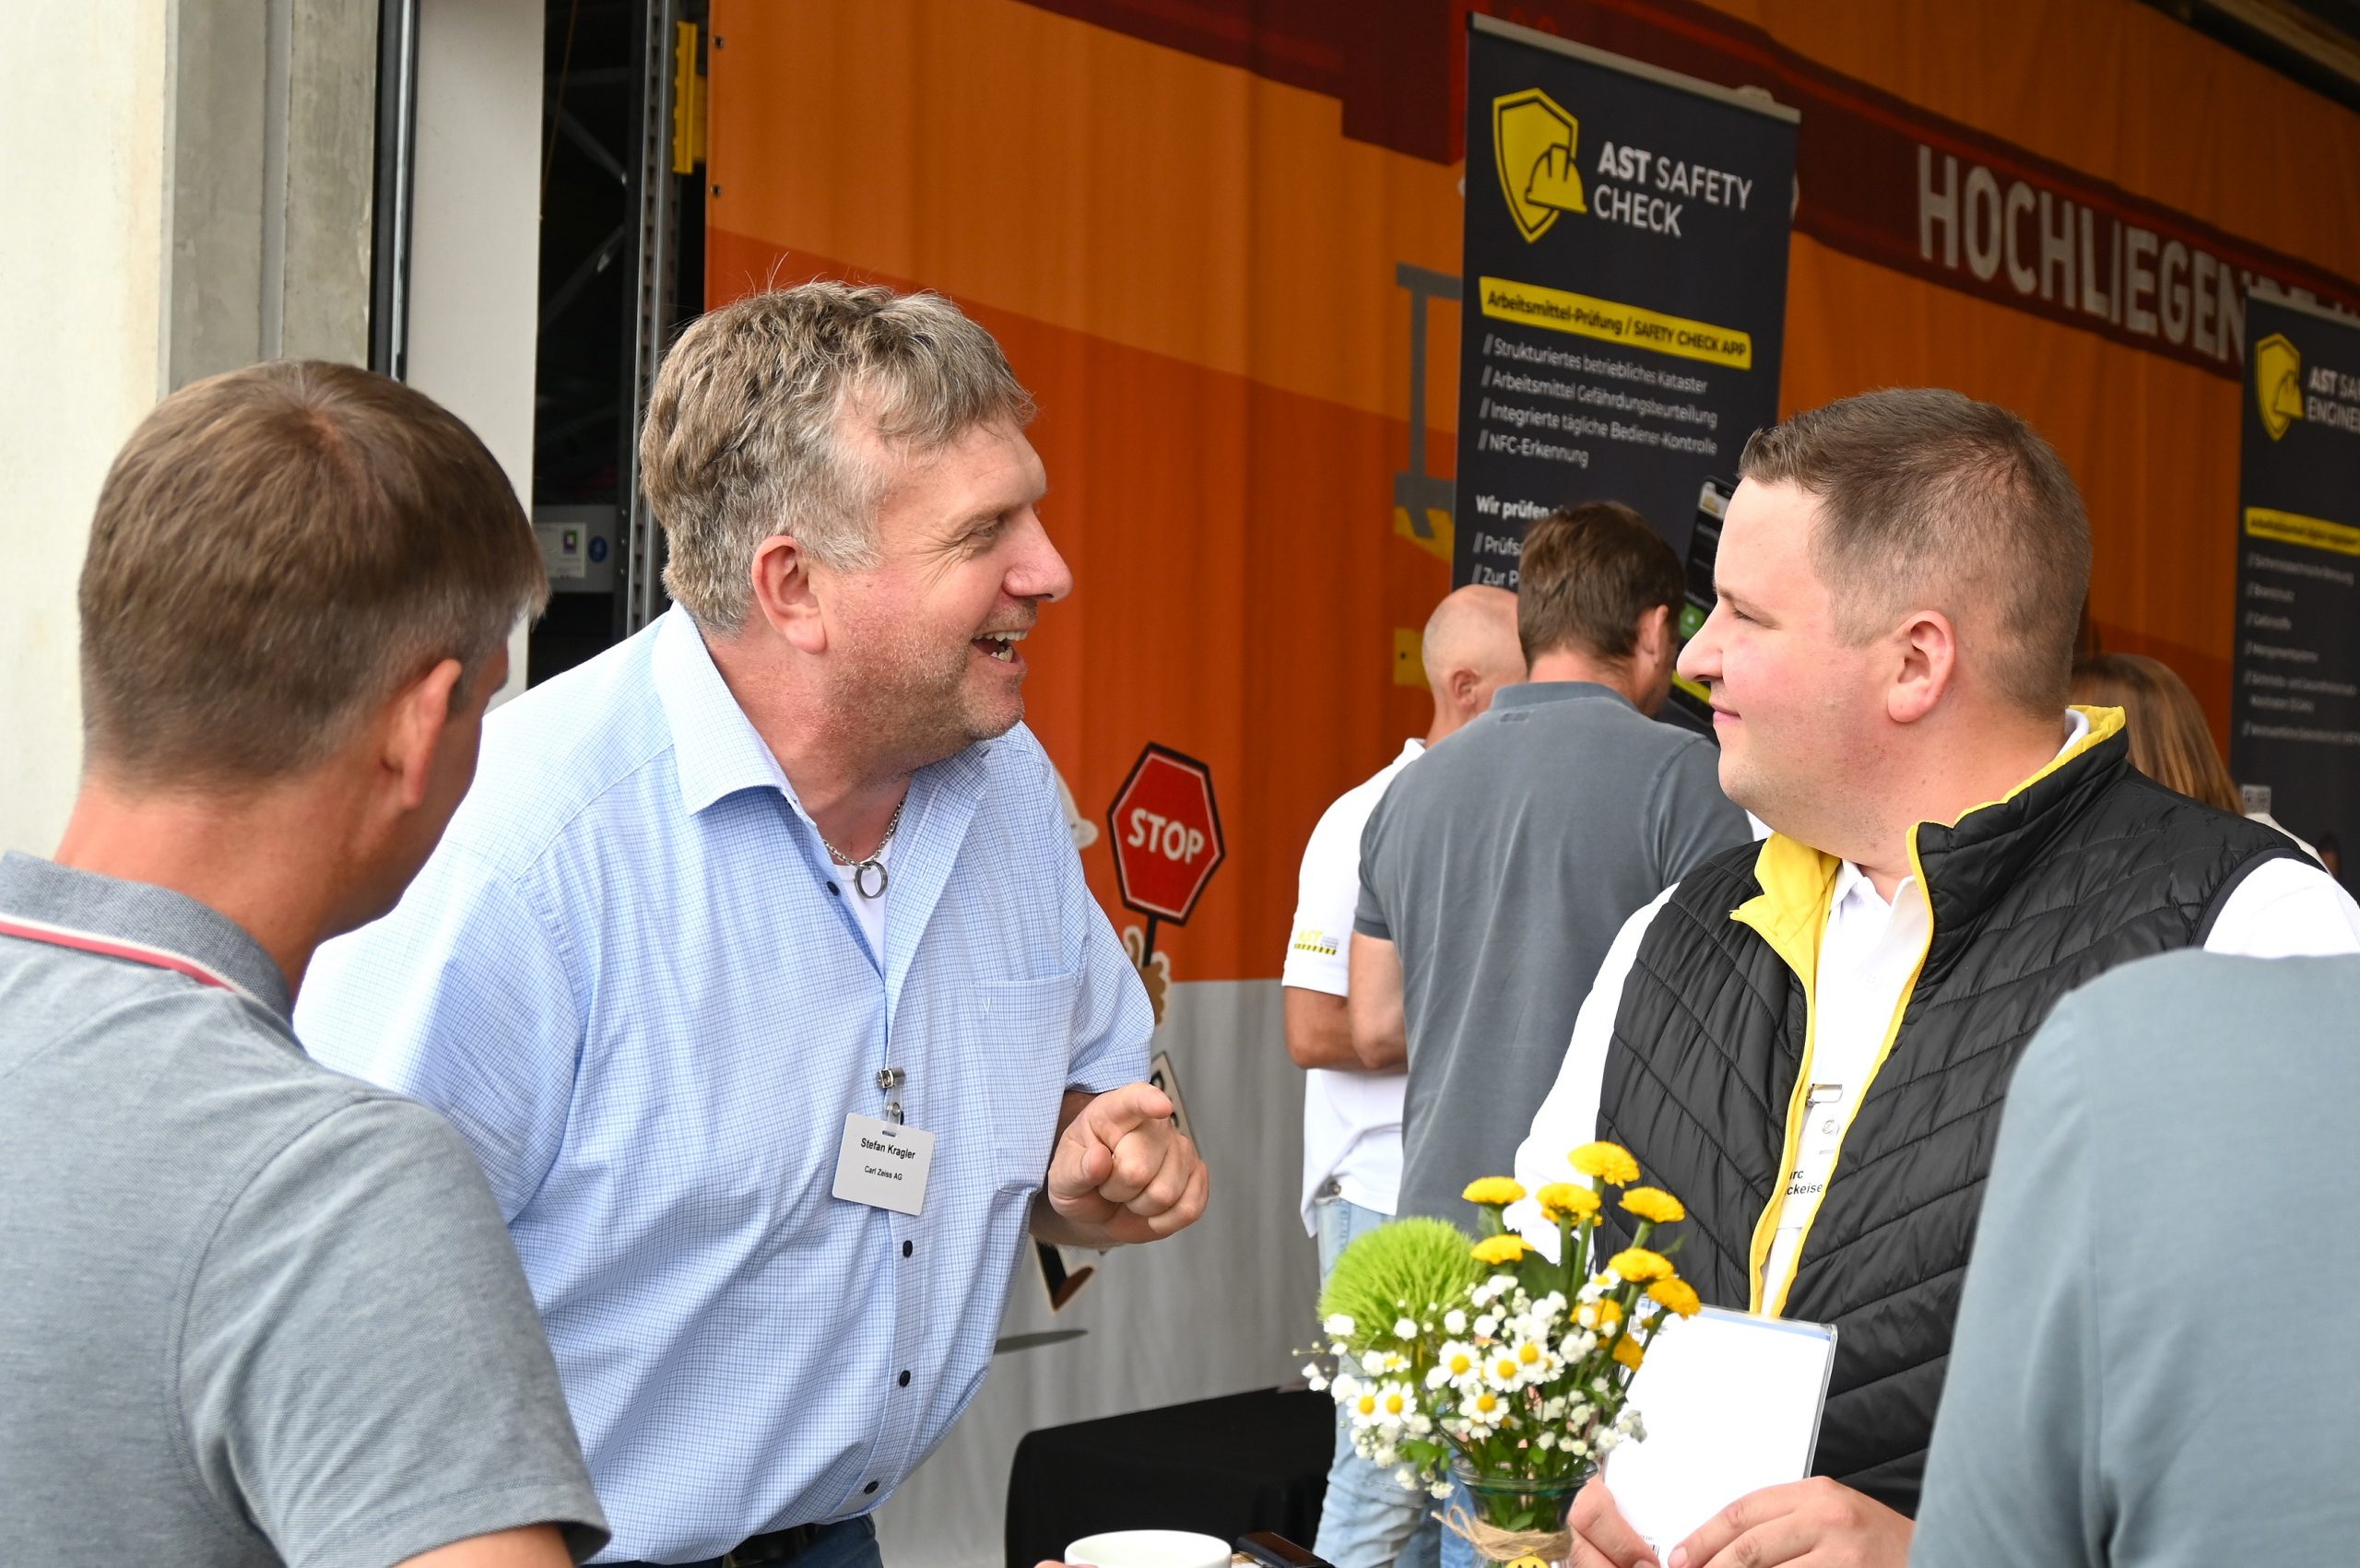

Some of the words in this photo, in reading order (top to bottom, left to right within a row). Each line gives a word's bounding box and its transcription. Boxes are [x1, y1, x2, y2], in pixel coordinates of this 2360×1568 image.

[1597, 141, 1652, 185] AST
[1656, 156, 1752, 212] SAFETY
[1593, 183, 1683, 239] CHECK
[1918, 144, 2318, 364] HOCHLIEGEN
[1487, 290, 1622, 336] Arbeitsmittel-Prüfung
[1634, 320, 1675, 343] SAFETY
[1677, 330, 1719, 351] CHECK
[1722, 339, 1747, 357] APP
[1493, 337, 1583, 371] Strukturiertes
[1658, 370, 1708, 395] Kataster
[2307, 366, 2338, 395] AST
[2338, 373, 2360, 402] SA
[1493, 369, 1576, 401] Arbeitsmittel
[1491, 401, 1560, 430] Integrierte
[1561, 413, 1609, 438] tägliche
[1489, 433, 1589, 469] NFC-Erkennung
[1476, 494, 1501, 514] Wir
[1502, 500, 1550, 521] prüfen
[1484, 536, 1522, 557] Prüfs
[1482, 567, 1504, 586] Zur
[1127, 808, 1204, 865] STOP
[860, 1138, 886, 1152] Stefan
[887, 1143, 916, 1160] Kragler
[864, 1165, 877, 1174] Carl
[877, 1168, 892, 1179] Zeiss
[893, 1172, 903, 1181] AG
[1785, 1184, 1823, 1196] ckeise
[1789, 1171, 1804, 1180] rc
